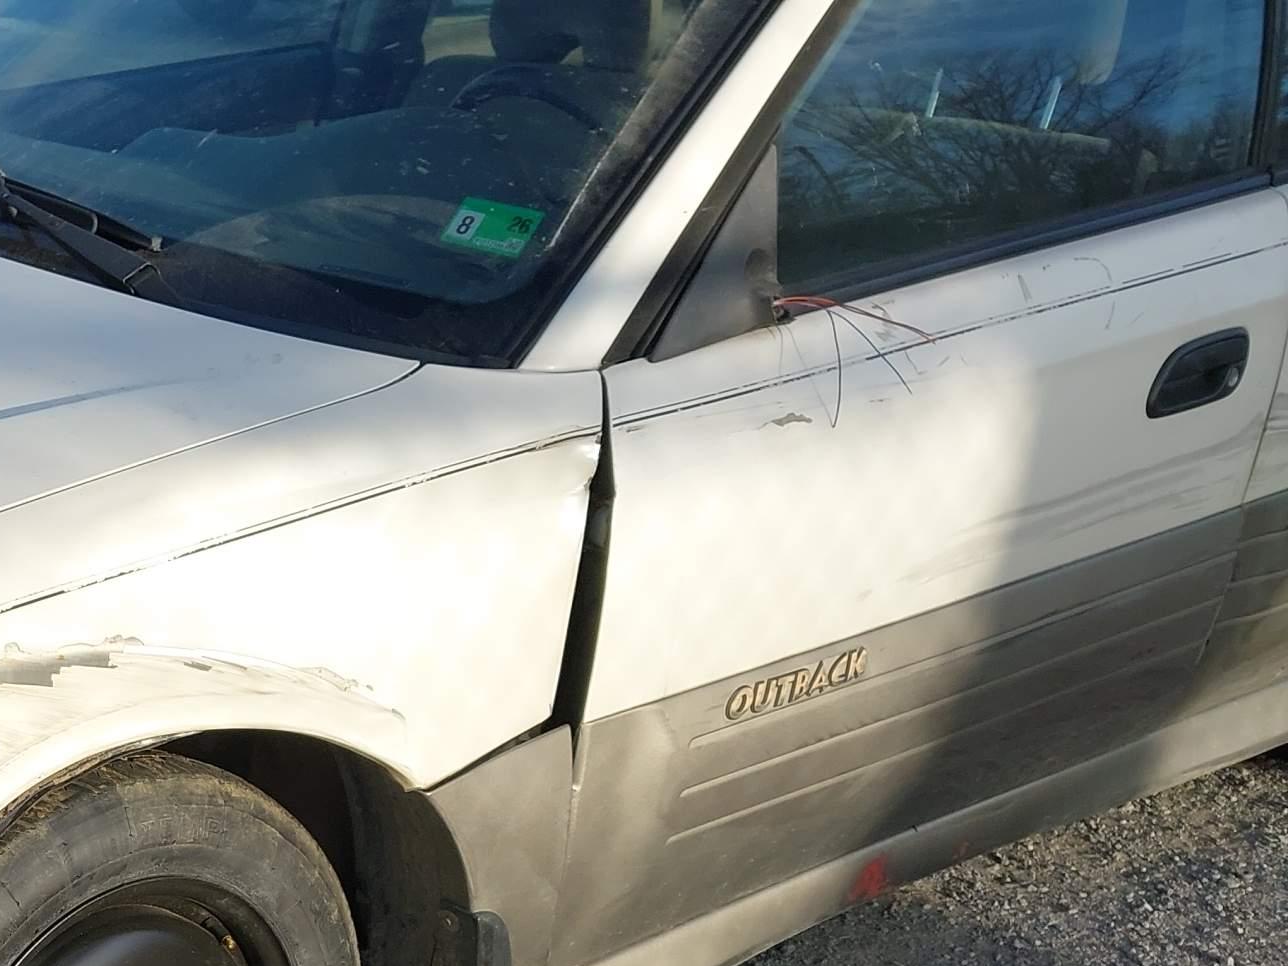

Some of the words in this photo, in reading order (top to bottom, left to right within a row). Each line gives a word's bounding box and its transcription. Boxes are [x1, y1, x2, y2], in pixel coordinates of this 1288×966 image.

[455, 215, 476, 235] 8
[506, 215, 534, 234] 26
[725, 646, 868, 720] OUTBACK
